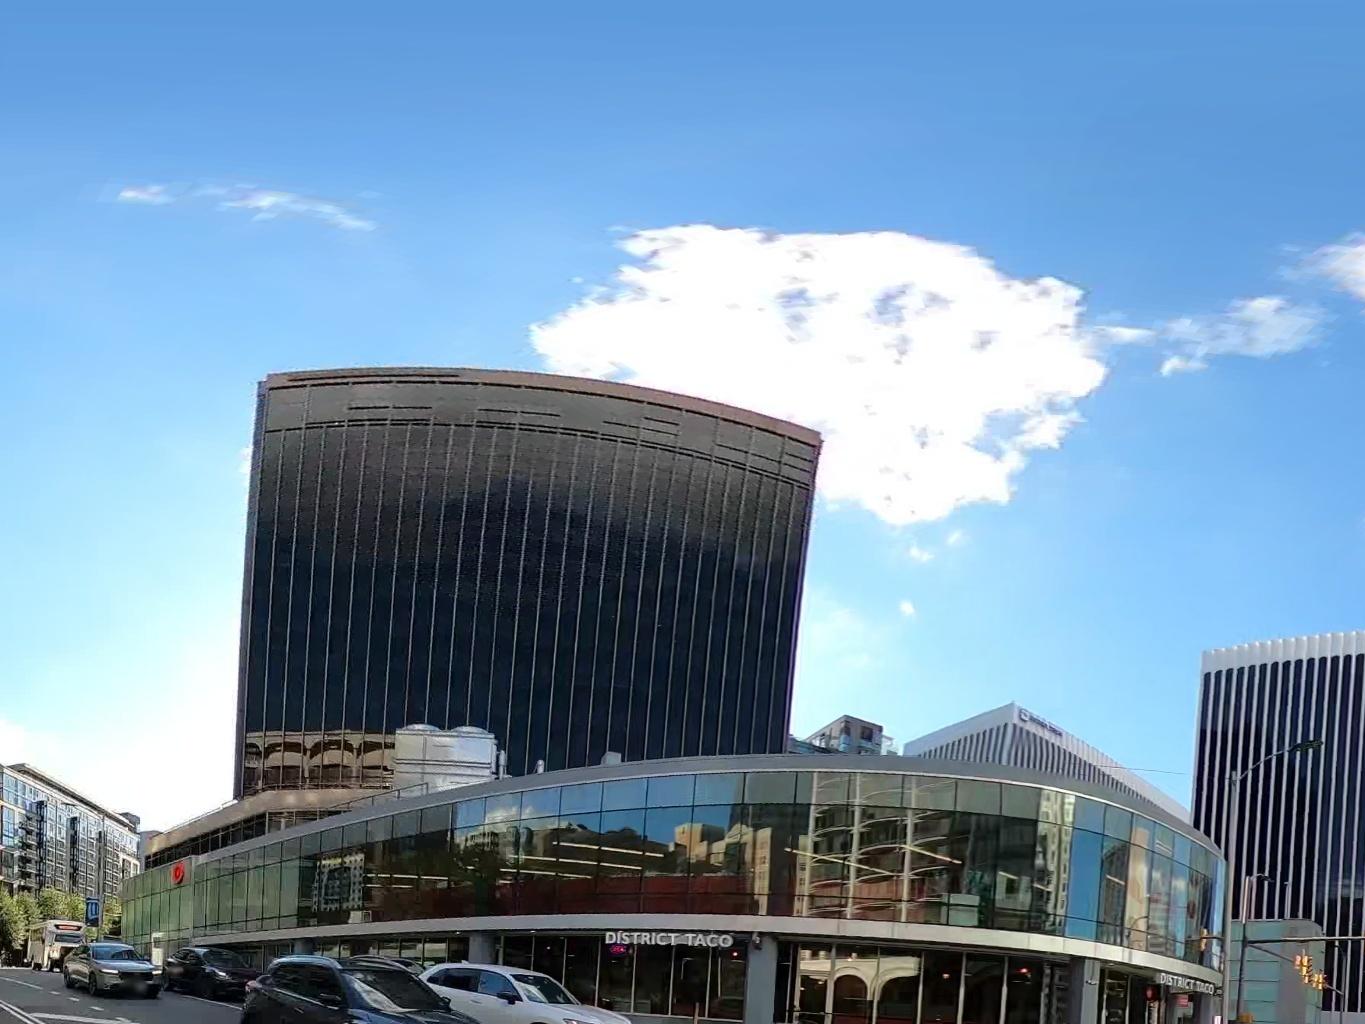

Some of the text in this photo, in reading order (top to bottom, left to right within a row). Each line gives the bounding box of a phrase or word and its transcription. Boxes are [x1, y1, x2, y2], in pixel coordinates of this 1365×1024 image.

[604, 931, 734, 948] DISTRICT TACO
[1160, 972, 1215, 996] DISTRICT TACO
